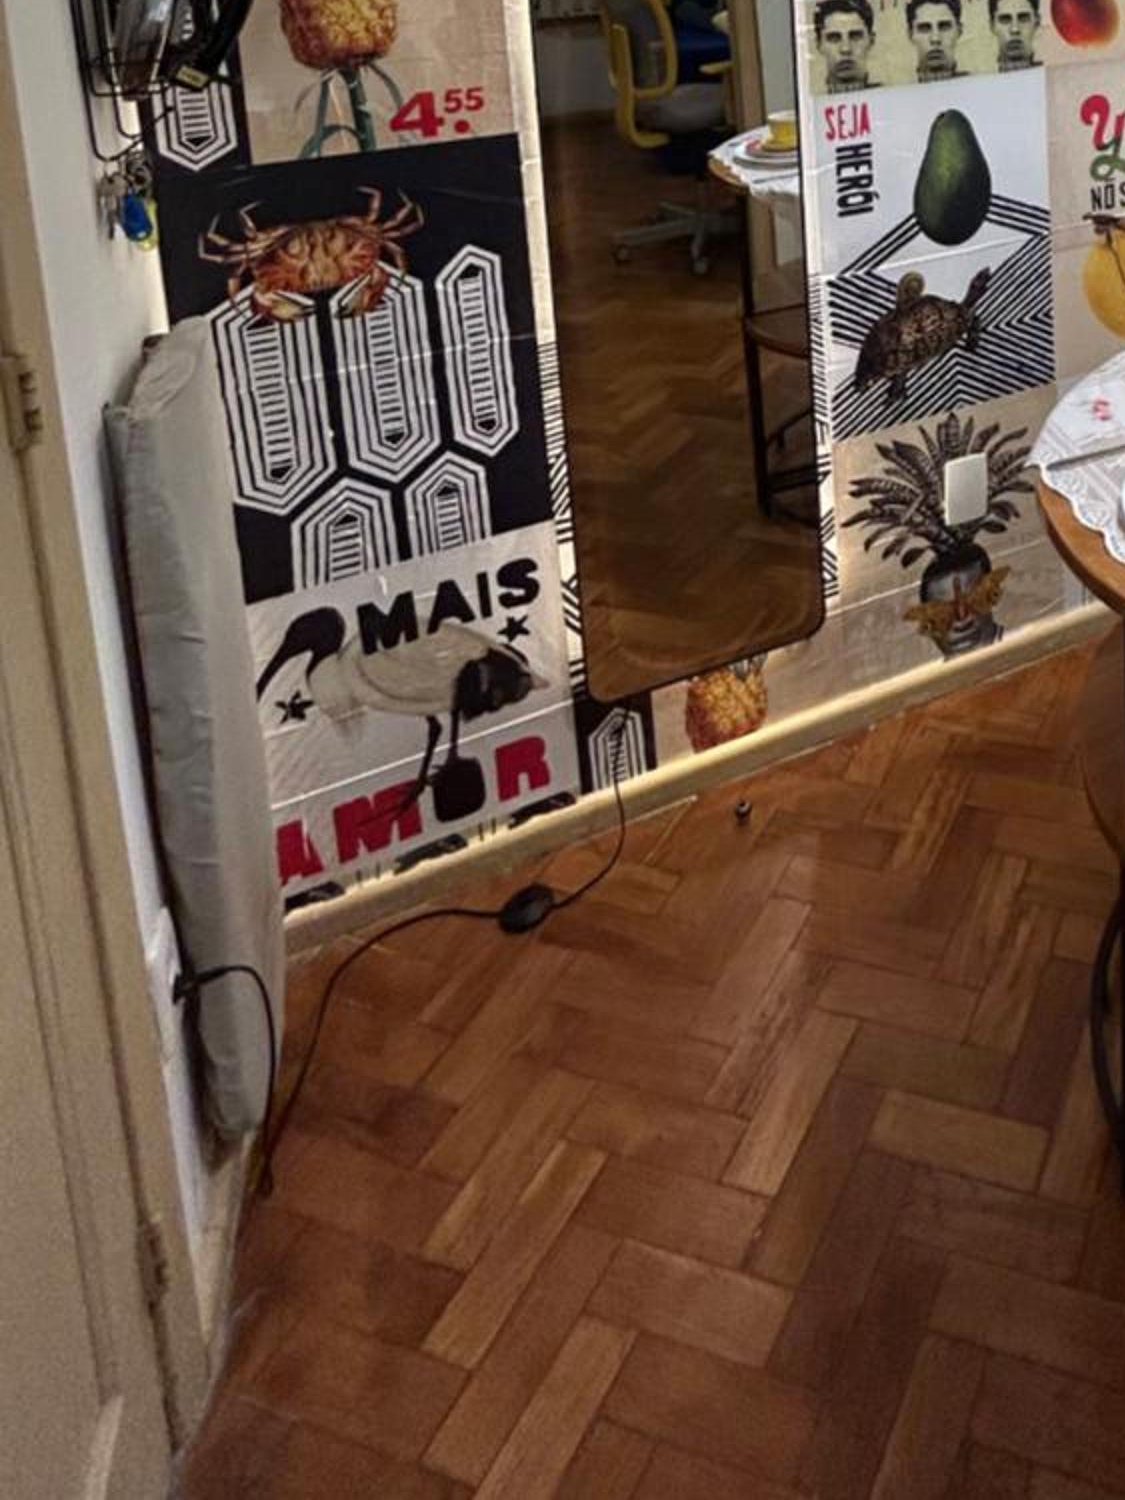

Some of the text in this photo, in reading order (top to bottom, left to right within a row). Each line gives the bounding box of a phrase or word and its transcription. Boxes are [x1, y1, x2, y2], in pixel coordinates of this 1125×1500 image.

[824, 101, 871, 141] SEJA
[836, 142, 880, 218] HERÓI
[357, 558, 539, 656] MAIS
[276, 736, 551, 886] AMOR
